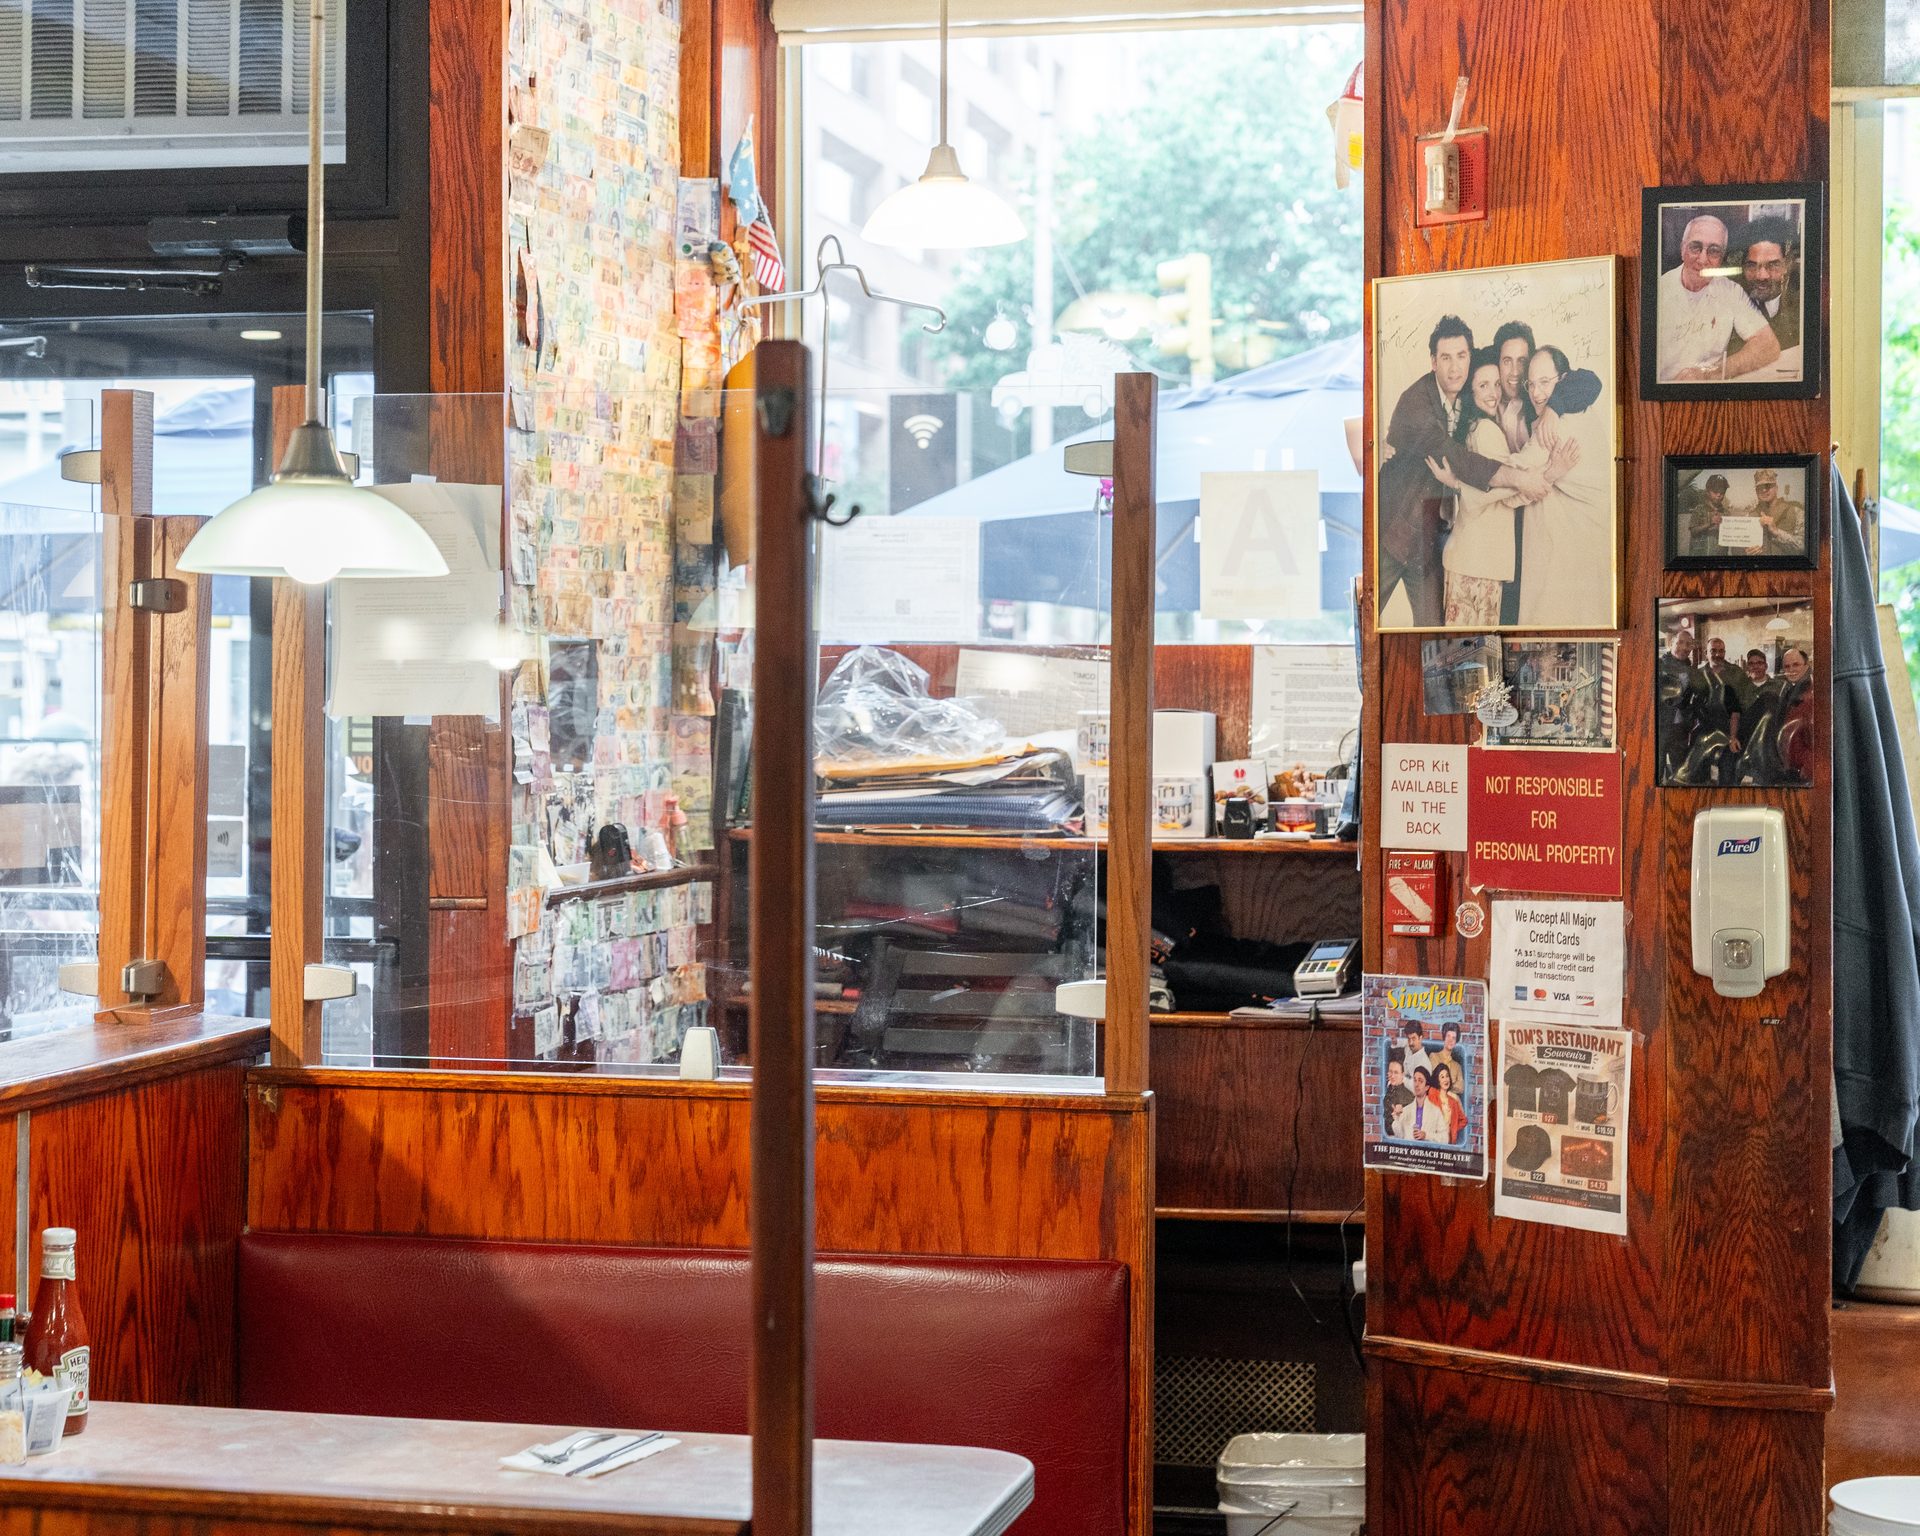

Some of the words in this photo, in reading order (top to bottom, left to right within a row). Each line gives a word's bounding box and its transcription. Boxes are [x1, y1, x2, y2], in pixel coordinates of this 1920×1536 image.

[1399, 759, 1424, 772] CPR
[1432, 760, 1450, 772] Kit
[1391, 780, 1458, 793] AVAILABLE
[1486, 776, 1511, 794] NOT
[1516, 777, 1604, 797] RESPONSIBLE
[1402, 801, 1414, 812] IN
[1422, 801, 1446, 814] THE
[1531, 810, 1556, 830] FOR
[1407, 822, 1441, 834] BACK
[1476, 841, 1542, 862] PERSONAL
[1546, 845, 1615, 865] PROPERTY
[1722, 840, 1756, 853] Purell
[1389, 859, 1401, 869] FIRE
[1414, 860, 1433, 869] ALARM
[1515, 909, 1527, 921] We
[1530, 910, 1558, 927] Accept
[1560, 912, 1570, 925] All
[1572, 913, 1596, 930] Major
[1530, 930, 1554, 944] Credit
[1557, 932, 1580, 946] Cards
[1537, 951, 1570, 961] surcharge
[1586, 954, 1595, 962] be
[1516, 960, 1537, 968] added
[1539, 961, 1546, 969] to
[1578, 965, 1594, 973] card
[1534, 971, 1575, 981] transactions
[1386, 982, 1464, 1012] Singfeld
[1553, 992, 1570, 1001] VISA
[1509, 1029, 1544, 1045] TOM'S
[1547, 1030, 1623, 1057] RESTAURANT
[1543, 1048, 1586, 1061] Souvenirs
[1544, 1115, 1554, 1123] $27
[1373, 1145, 1388, 1153] THE
[1389, 1146, 1409, 1155] JERRY
[1410, 1149, 1440, 1158] ORBACH
[1440, 1152, 1471, 1162] THEATER
[1532, 1172, 1543, 1180] $22
